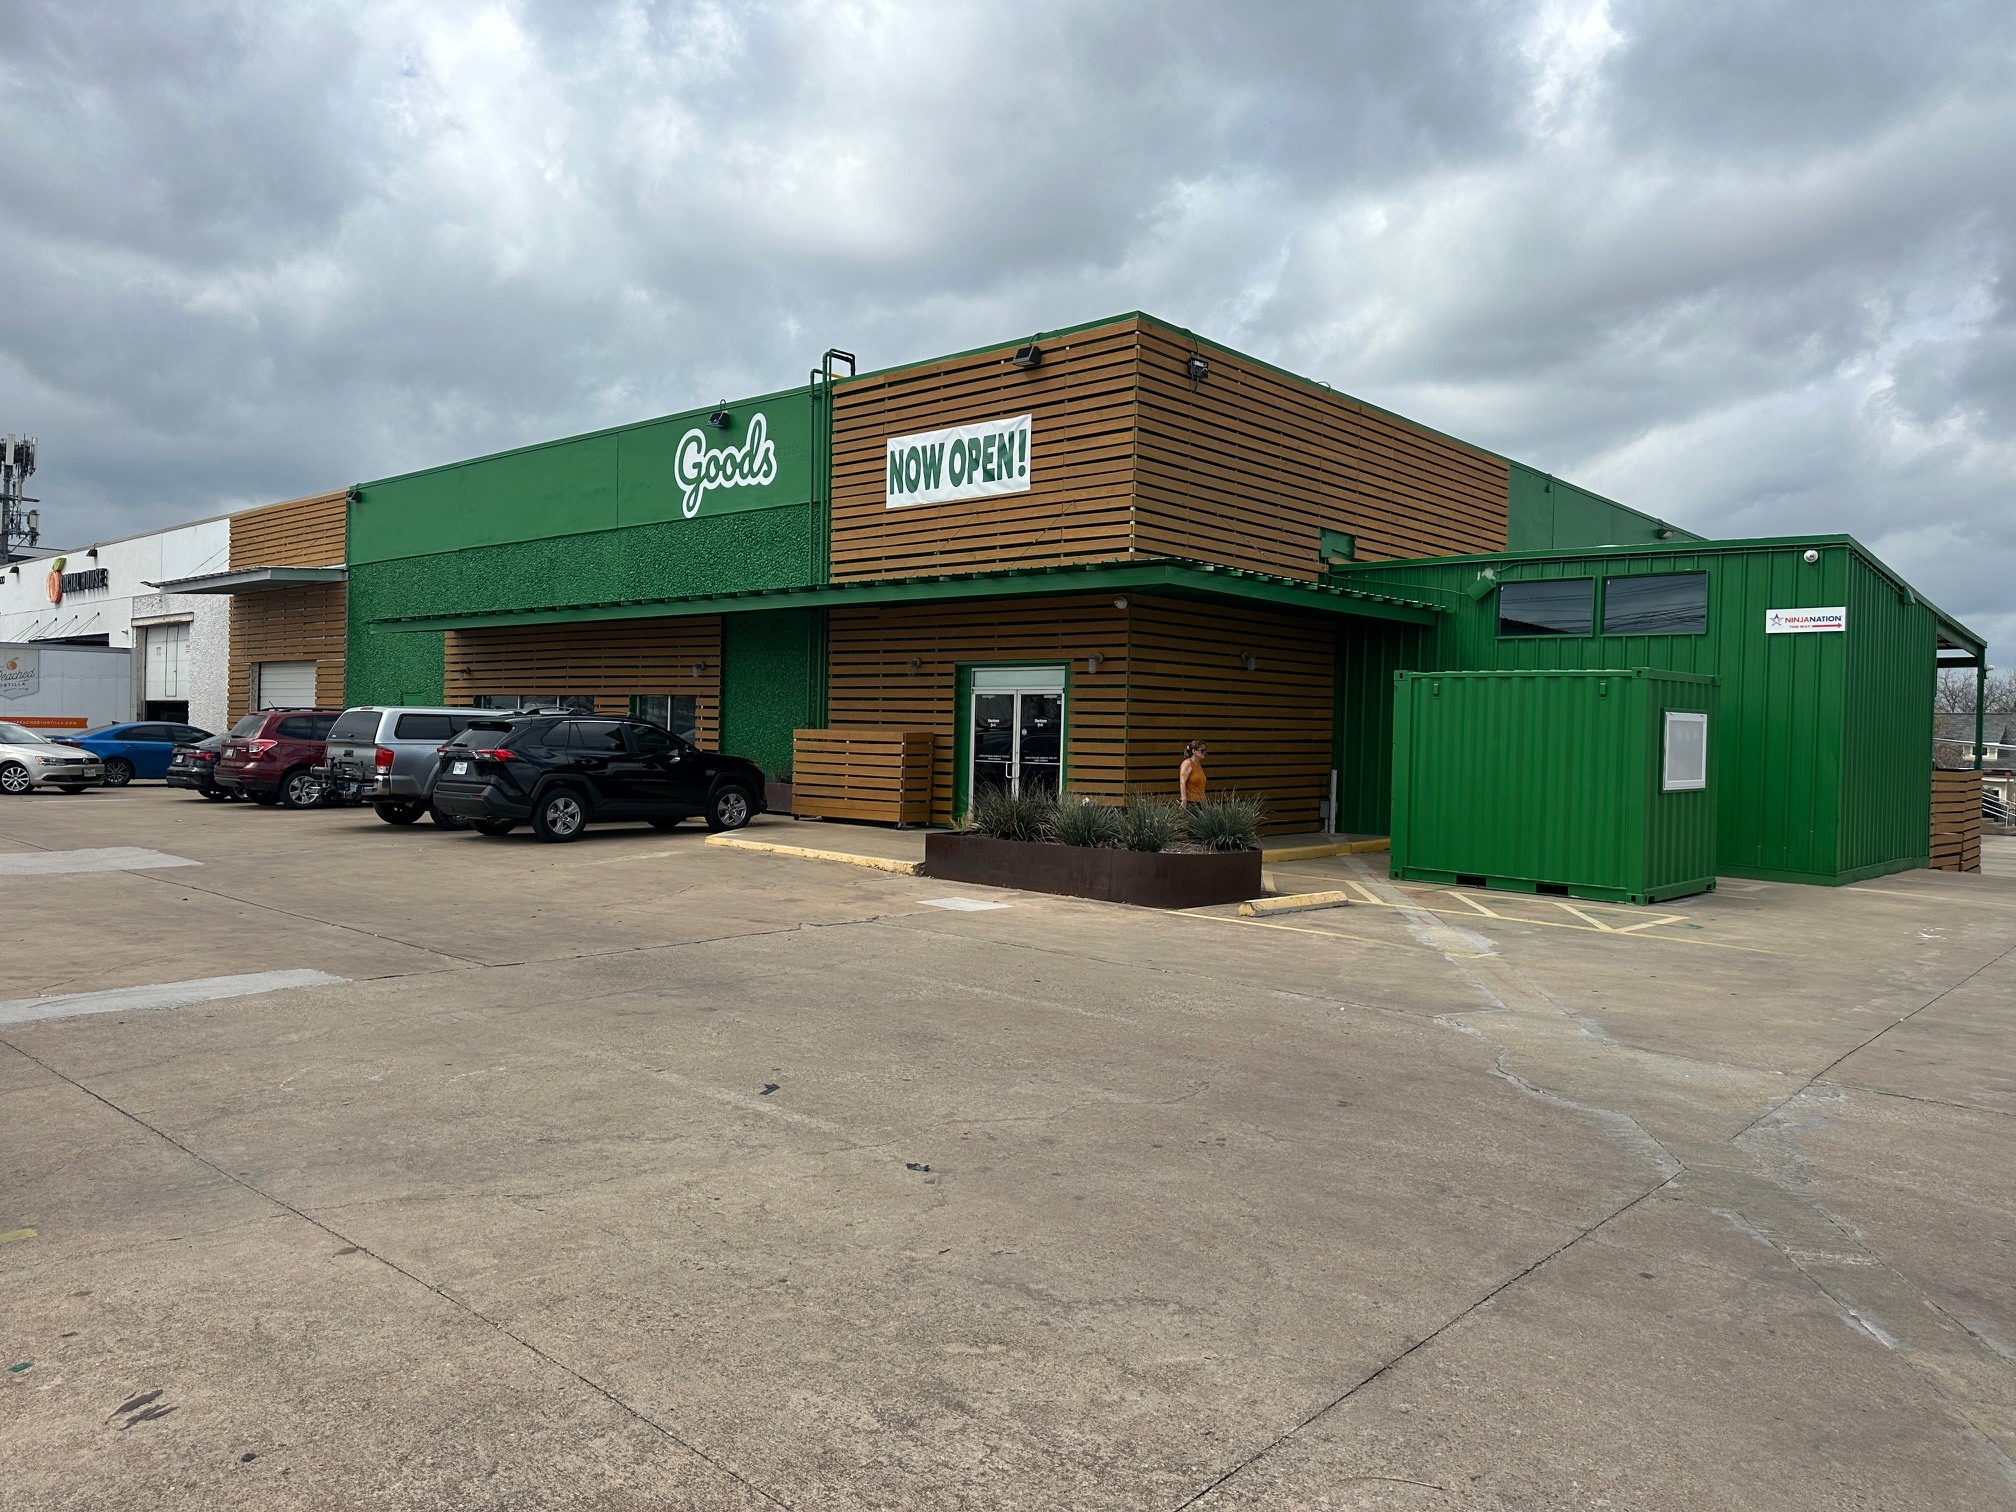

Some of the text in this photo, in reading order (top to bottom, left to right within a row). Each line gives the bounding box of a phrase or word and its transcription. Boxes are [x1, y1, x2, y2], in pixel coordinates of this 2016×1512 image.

[674, 413, 777, 518] Goods
[890, 429, 1027, 495] NOW OPEN!
[1785, 615, 1842, 623] NINJANATION
